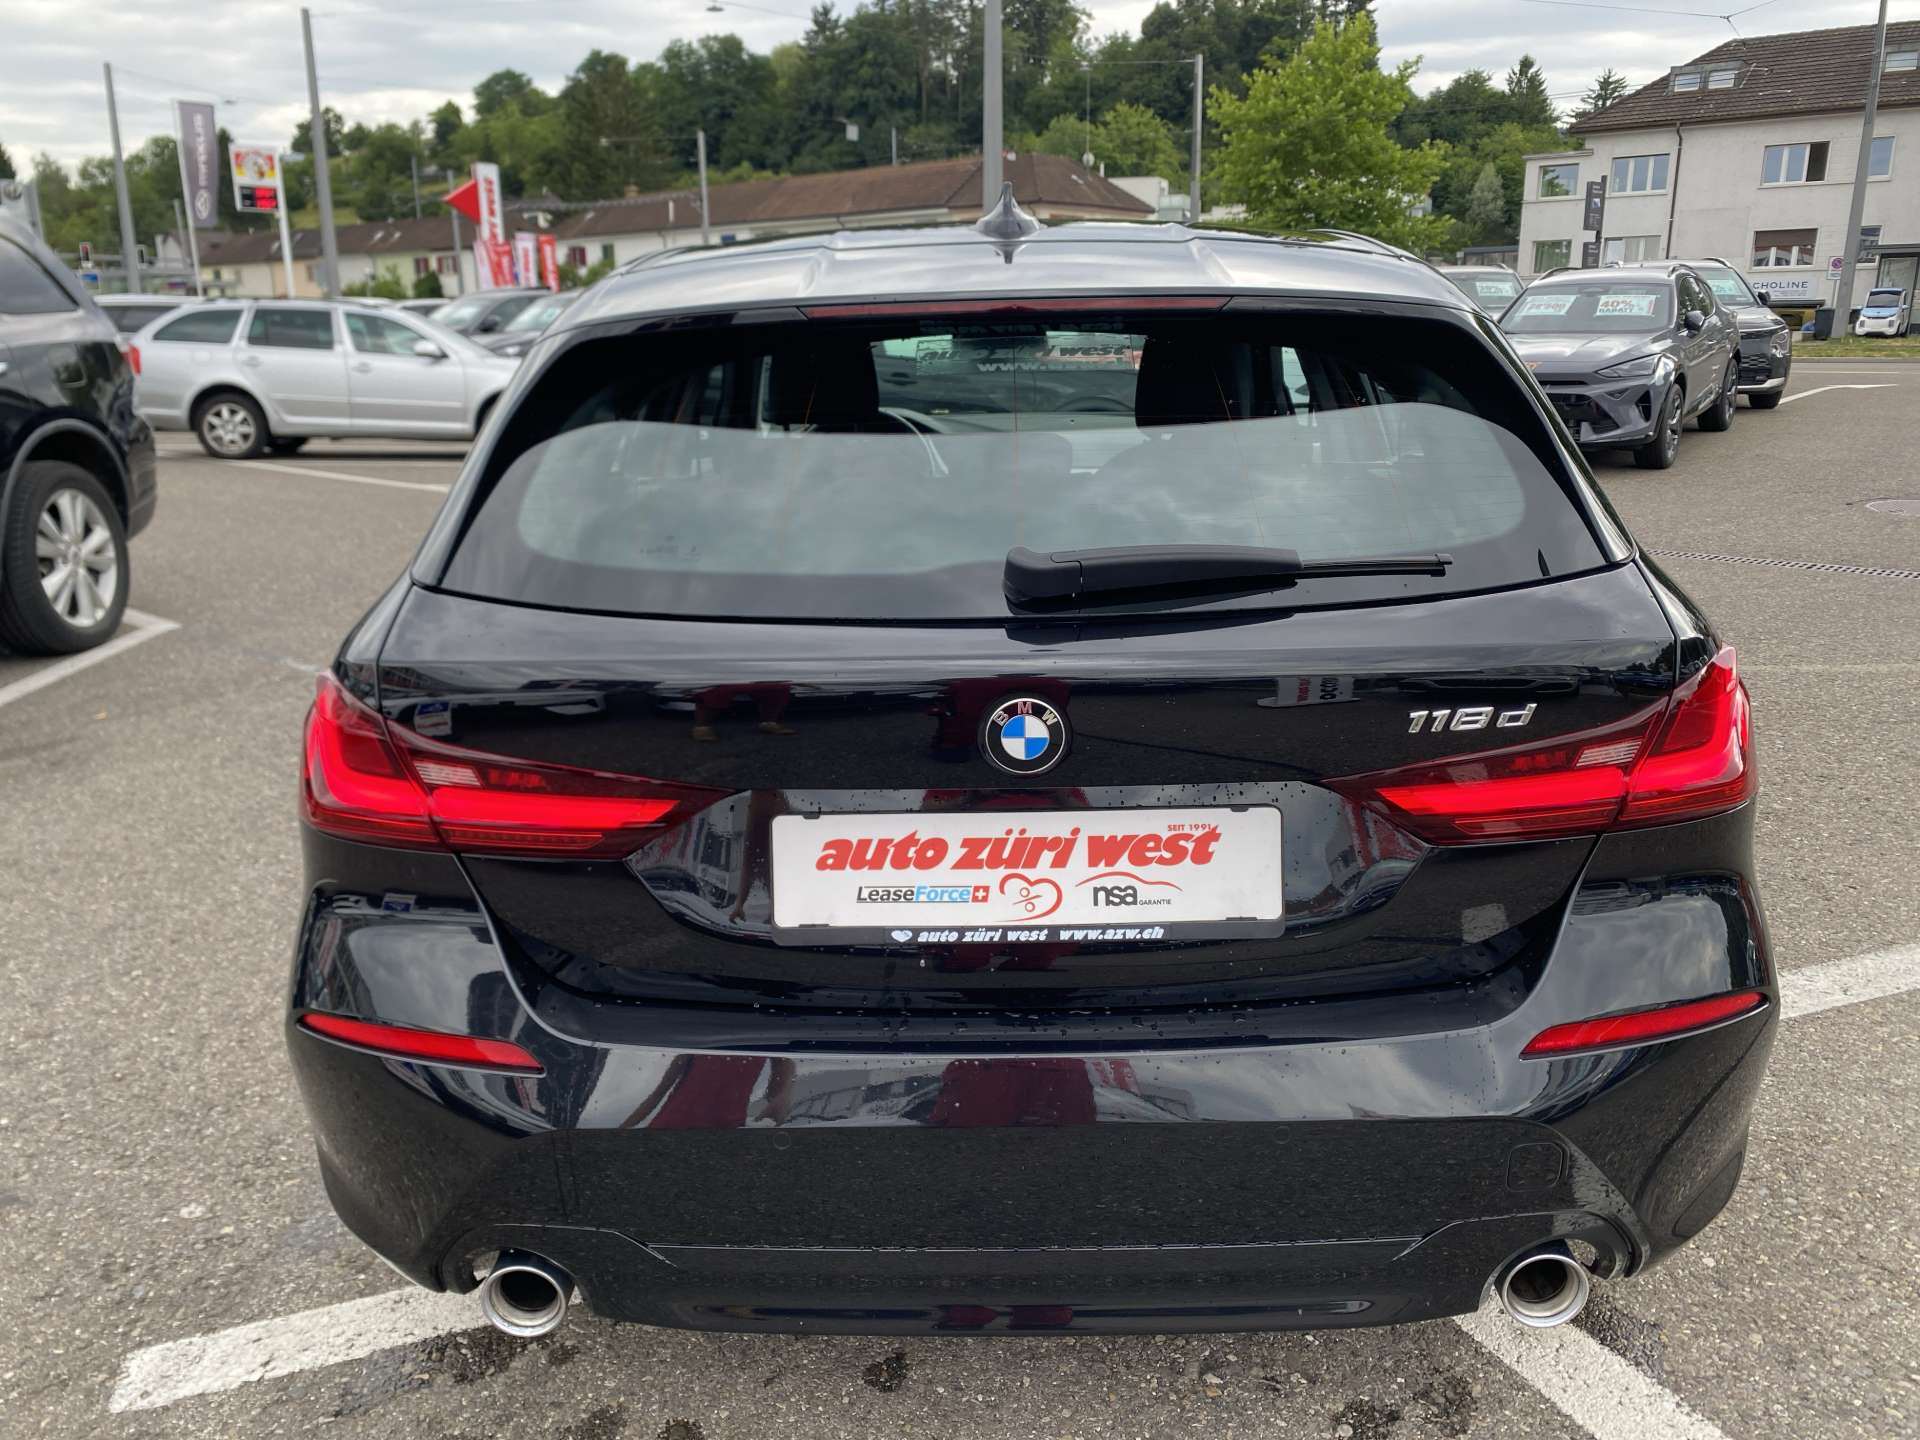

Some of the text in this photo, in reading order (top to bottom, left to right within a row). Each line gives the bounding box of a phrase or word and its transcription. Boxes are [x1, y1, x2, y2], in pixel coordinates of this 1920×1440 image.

[1753, 281, 1808, 289] CHOLINE
[993, 702, 1057, 727] BMW
[1408, 703, 1538, 733] 118d
[1189, 823, 1211, 831] 1991
[816, 826, 1222, 871] auto züri west
[857, 886, 970, 902] LeaseForce
[1093, 885, 1138, 906] nsa
[917, 926, 1165, 942] auto züri west www.azw.ch
